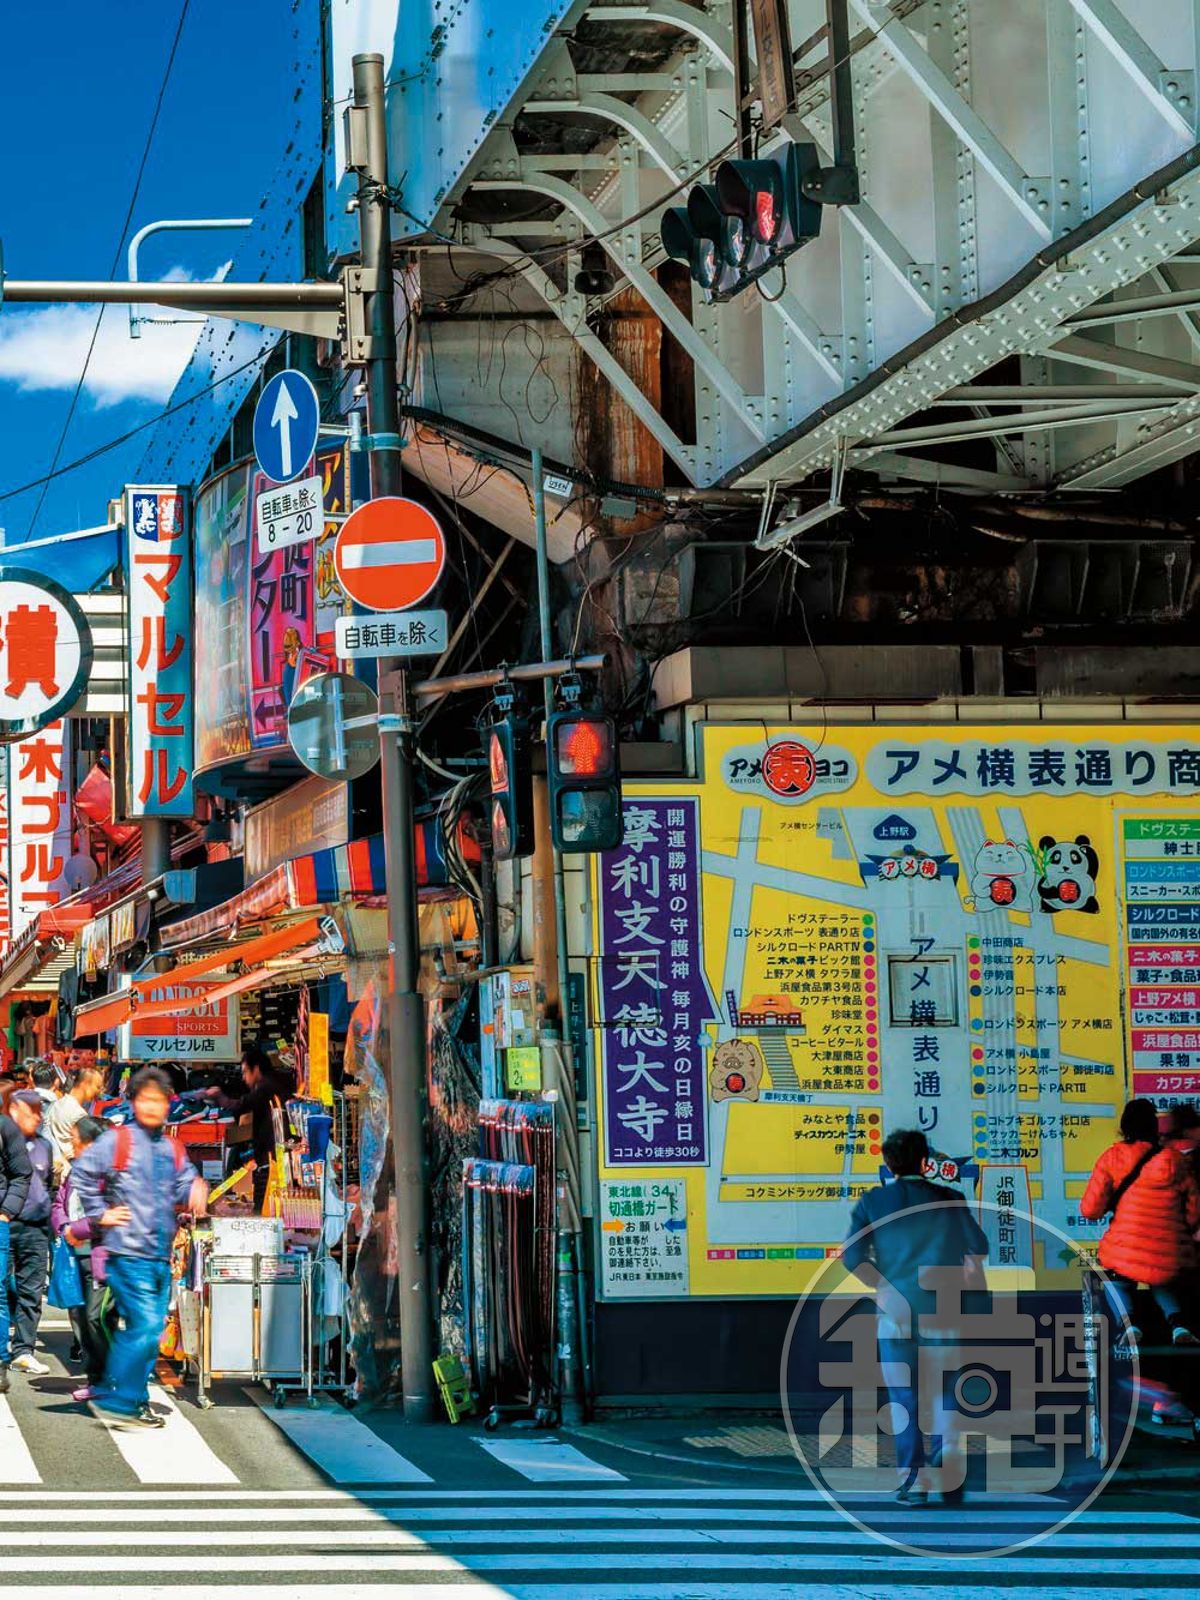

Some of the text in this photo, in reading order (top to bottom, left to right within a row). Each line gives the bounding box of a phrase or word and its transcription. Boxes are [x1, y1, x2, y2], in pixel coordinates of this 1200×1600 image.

[261, 488, 316, 520] 自転車を除く
[345, 621, 439, 649] 自転車を除く
[134, 553, 188, 806] マルセル
[886, 749, 1200, 788] アメ横表通り商
[879, 826, 910, 837] 上野駅
[1163, 841, 1200, 855] 紳士
[883, 858, 937, 876] アメ横
[787, 914, 860, 924] ドヴステーラー
[1132, 908, 1200, 922] シルクロード
[733, 928, 860, 938] ロンドンスポーツ 表通り店
[1132, 927, 1200, 940] 国内国外の有名
[757, 942, 816, 952] シルクロード
[982, 938, 1024, 948] 中田商店
[983, 955, 1066, 965] 珍味エクスプレス
[1133, 950, 1199, 964] 二木の菓子
[666, 808, 693, 1142] 開運勝利の守護神 毎月亥の日縁日
[764, 969, 861, 980] 上野アメ横 タワラ屋
[1136, 969, 1200, 983] 菓子・食品
[780, 982, 862, 993] 浜屋食品第3号店
[983, 986, 1067, 996] シルクロード本店
[800, 996, 863, 1006] カワチヤ食品
[1134, 991, 1196, 1006] 上野アメ横
[831, 1010, 863, 1020] 珍味堂
[176, 1022, 220, 1032] SPORTS
[985, 1018, 1113, 1029] ロンドンスポーツ アメ横店
[822, 1024, 863, 1035] ダイマス
[910, 937, 942, 1132] アメ横表通り
[145, 1039, 215, 1052] マルセル店
[1142, 1034, 1200, 1048] 浜屋食品
[811, 1051, 864, 1062] 大津屋商店
[986, 1049, 1050, 1059] アメ横 小島屋
[822, 1065, 864, 1076] 大東商店
[986, 1065, 1115, 1076] ロンドンスポーツ 御徒町店
[801, 1079, 865, 1090] 浜屋食品本店
[986, 1083, 1047, 1094] シルクロード
[1156, 1076, 1200, 1091] カワチ
[803, 1114, 866, 1125] みなとや食品
[988, 1116, 1091, 1127] コトブキゴルフ 北口店
[989, 1128, 1078, 1139] サッカーけんちゃん
[613, 1146, 701, 1158] ココより徒歩30秒
[834, 1144, 866, 1155] 伊勢屋
[990, 1148, 1039, 1159] 二木ゴルフ
[625, 1221, 666, 1233] お願い
[608, 1235, 681, 1246] 自動車等が した
[609, 1273, 641, 1282] JR東日本
